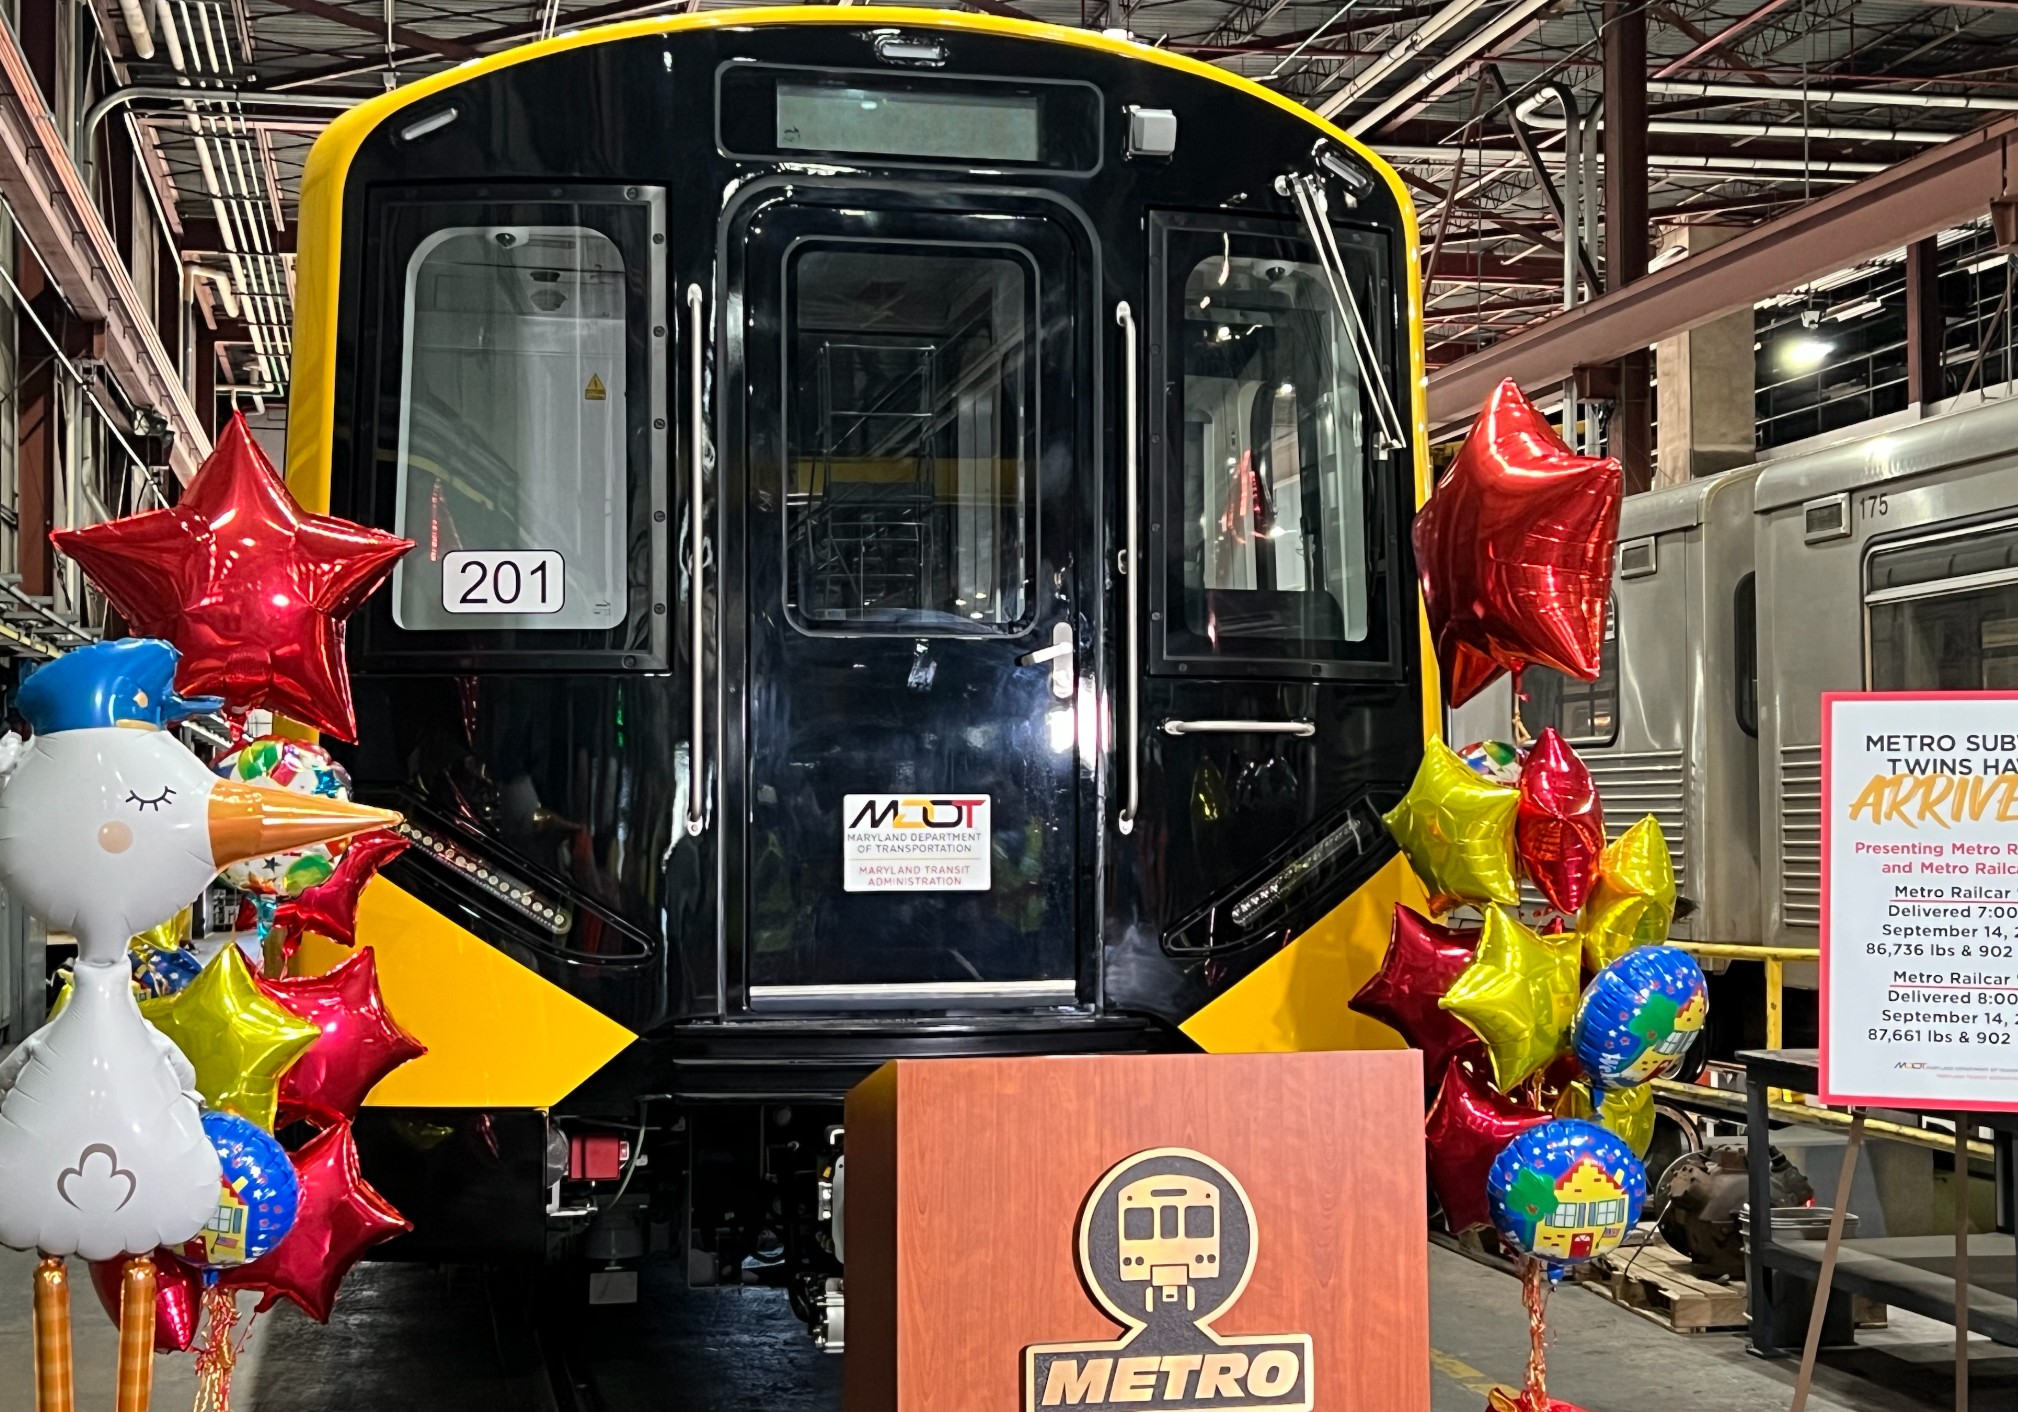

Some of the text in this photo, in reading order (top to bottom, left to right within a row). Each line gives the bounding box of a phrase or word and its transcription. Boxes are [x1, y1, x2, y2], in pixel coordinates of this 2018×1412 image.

[1860, 493, 1888, 520] 175
[459, 560, 547, 604] 201
[1866, 734, 2018, 752] METRO SUB
[1887, 758, 2018, 776] TWINS HA
[849, 799, 987, 828] MDOT
[847, 832, 981, 842] MARYLAND DEPARTMENT
[857, 844, 972, 853] OF TRANSPORTATION
[1855, 841, 1944, 857] Presenting
[1951, 843, 2001, 855] Metro
[859, 865, 970, 875] MARYLAND TRANSIT
[1882, 861, 2018, 875] and Metro Railc
[868, 876, 962, 886] ADMINISTRATION
[1895, 885, 2011, 899] Metro Railcar
[1888, 904, 2018, 918] Delivered 7:00
[1882, 924, 1978, 939] September
[1984, 925, 2008, 941] 14,
[1866, 942, 2013, 958] 86,736 lbs & 902
[1893, 970, 2011, 985] Metro Railcar
[1888, 990, 2018, 1005] Delivered 8:00
[1882, 1009, 1978, 1024] September
[1984, 1012, 2008, 1027] 14,
[1868, 1028, 2011, 1044] 87,661 lbs & 902
[1041, 1349, 1299, 1406] METRO
